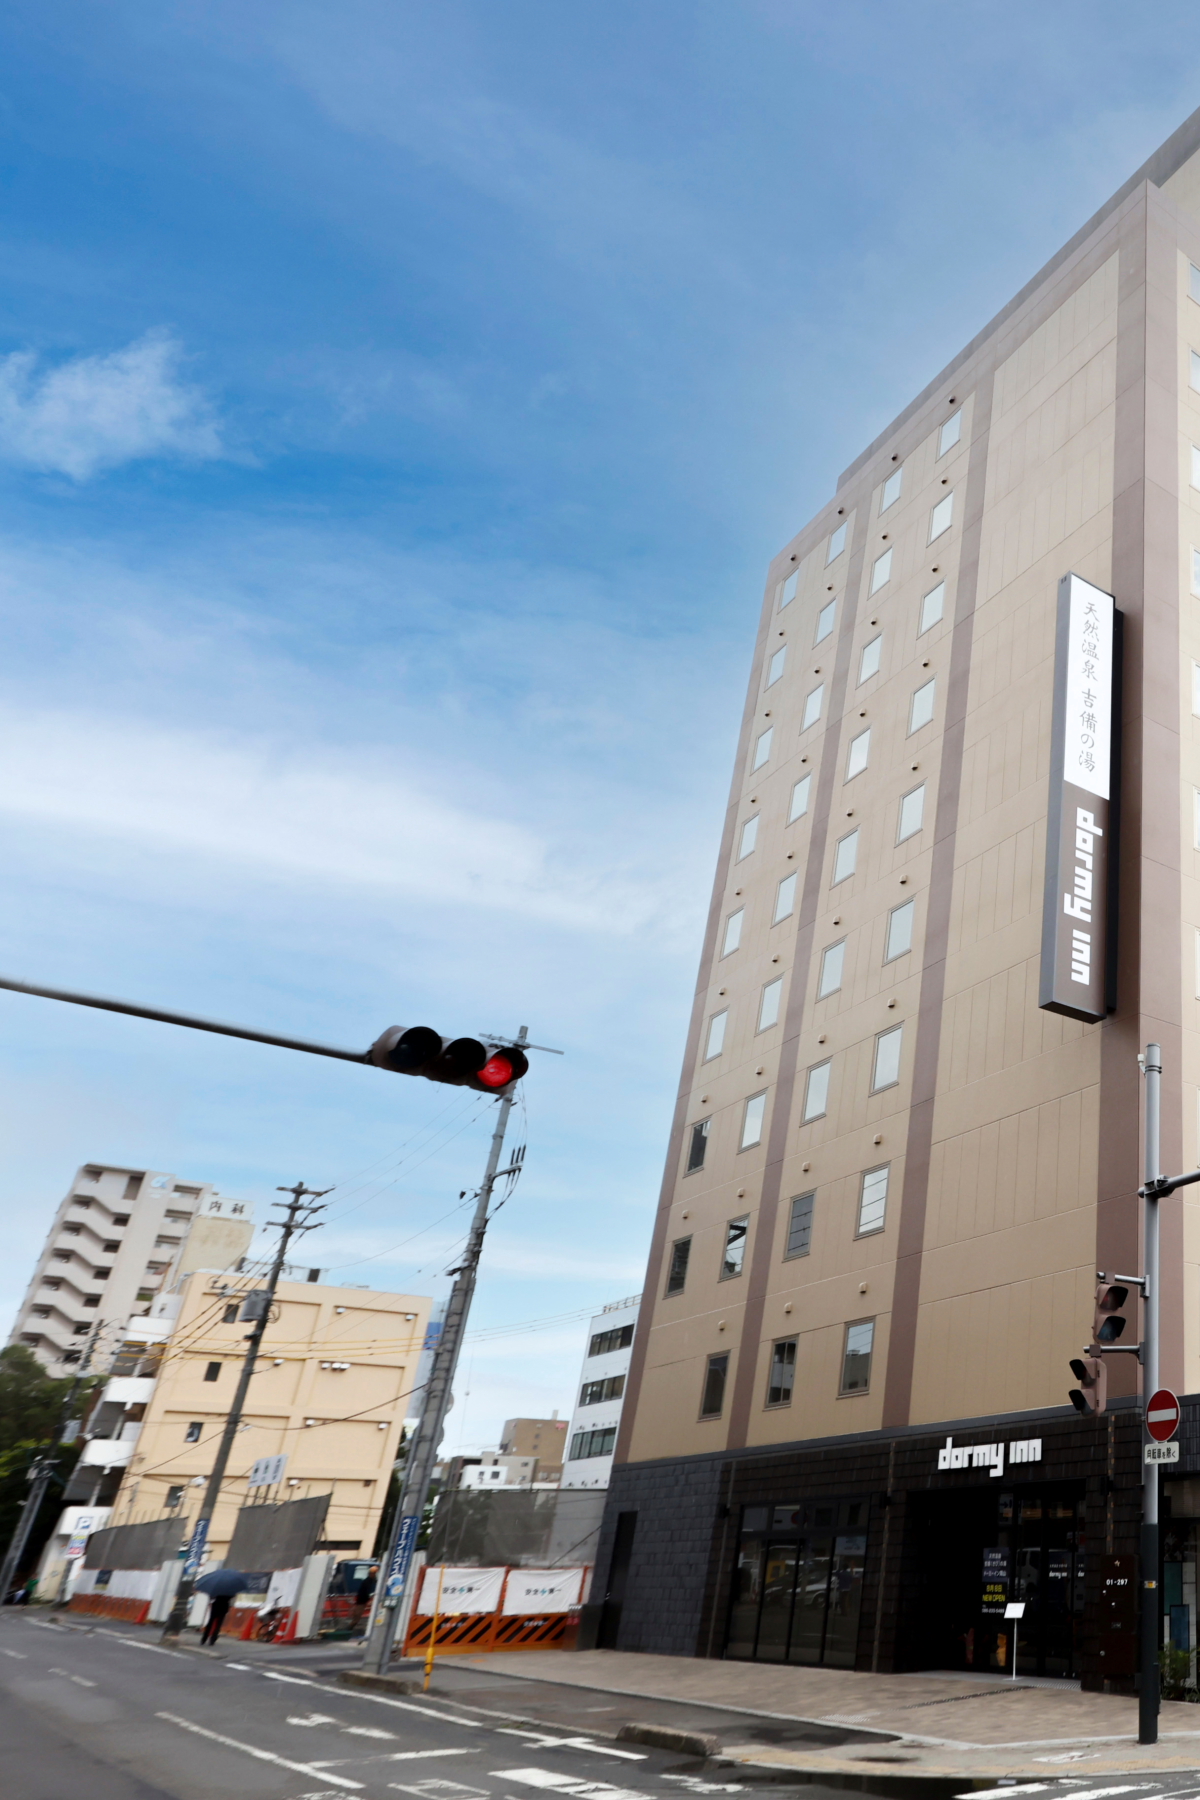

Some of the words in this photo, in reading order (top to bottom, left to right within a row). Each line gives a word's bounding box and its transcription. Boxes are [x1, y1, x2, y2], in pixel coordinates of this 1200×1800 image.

[1081, 601, 1100, 682] 天然温泉
[1078, 687, 1098, 773] 吉備の湯
[1063, 806, 1104, 923] dormy
[1070, 928, 1091, 986] inn
[208, 1200, 246, 1215] 内科
[937, 1436, 1005, 1478] dormy
[1009, 1438, 1043, 1464] inn
[1147, 1446, 1176, 1460] 自転車を除く
[1105, 1578, 1129, 1586] 01-297
